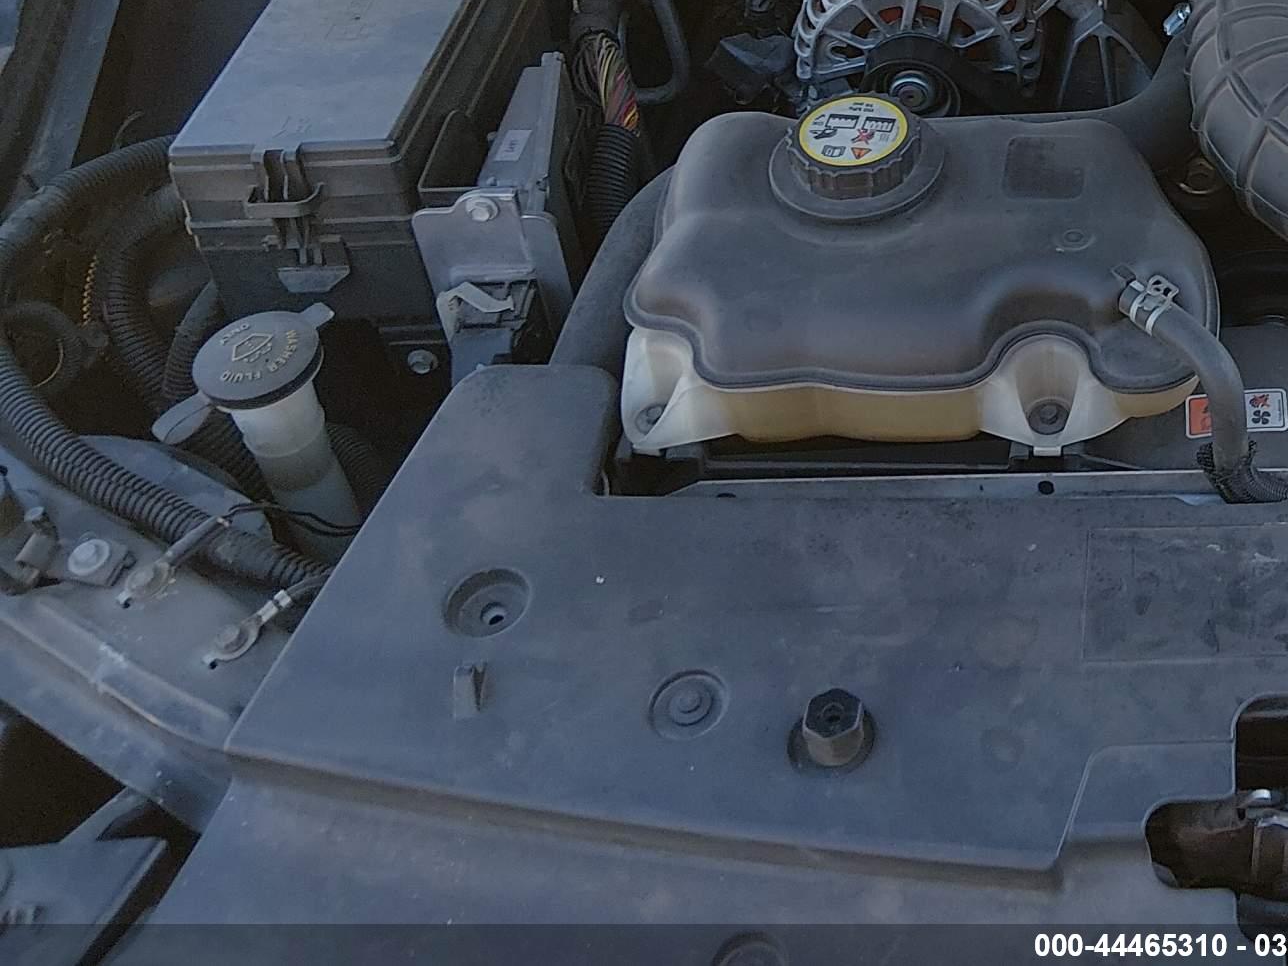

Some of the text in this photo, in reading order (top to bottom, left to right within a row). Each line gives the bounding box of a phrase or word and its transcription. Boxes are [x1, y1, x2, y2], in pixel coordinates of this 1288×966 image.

[219, 322, 250, 345] ONLY
[220, 329, 298, 383] WASHER FLUID
